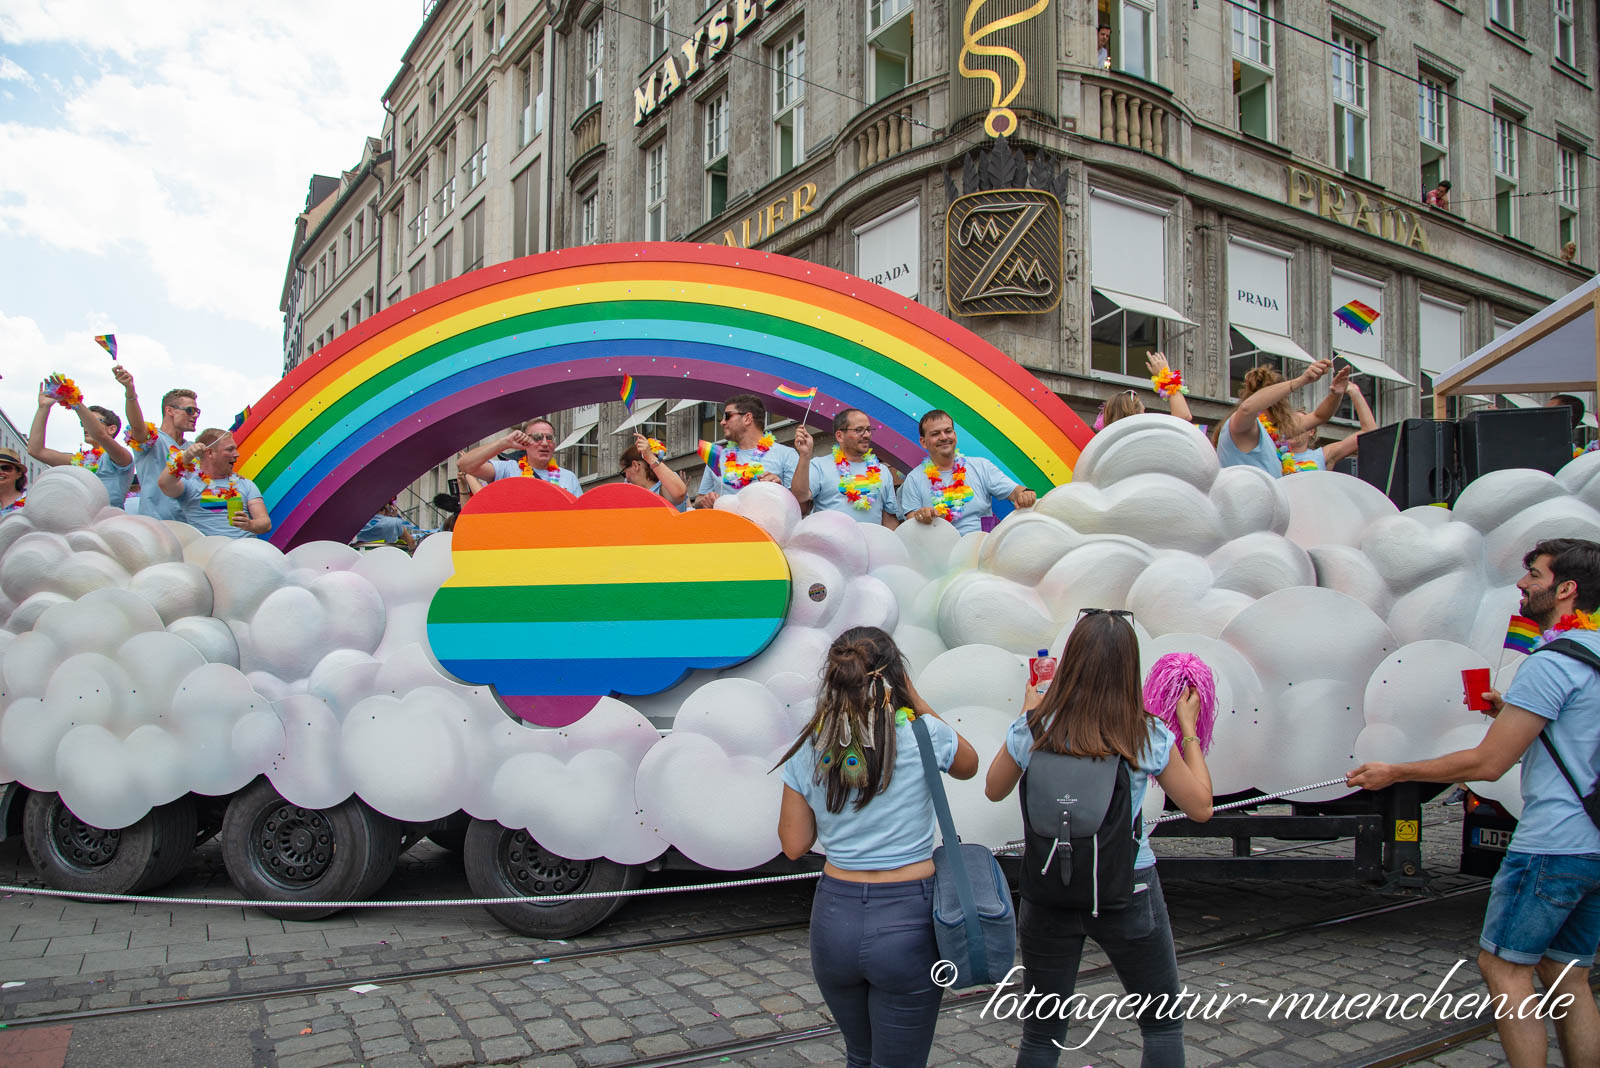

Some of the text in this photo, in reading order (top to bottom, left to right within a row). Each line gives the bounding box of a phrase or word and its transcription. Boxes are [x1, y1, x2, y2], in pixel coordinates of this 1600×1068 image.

[634, 0, 776, 126] MAYSE
[1286, 164, 1430, 254] PRADA
[1237, 289, 1279, 311] PRADA
